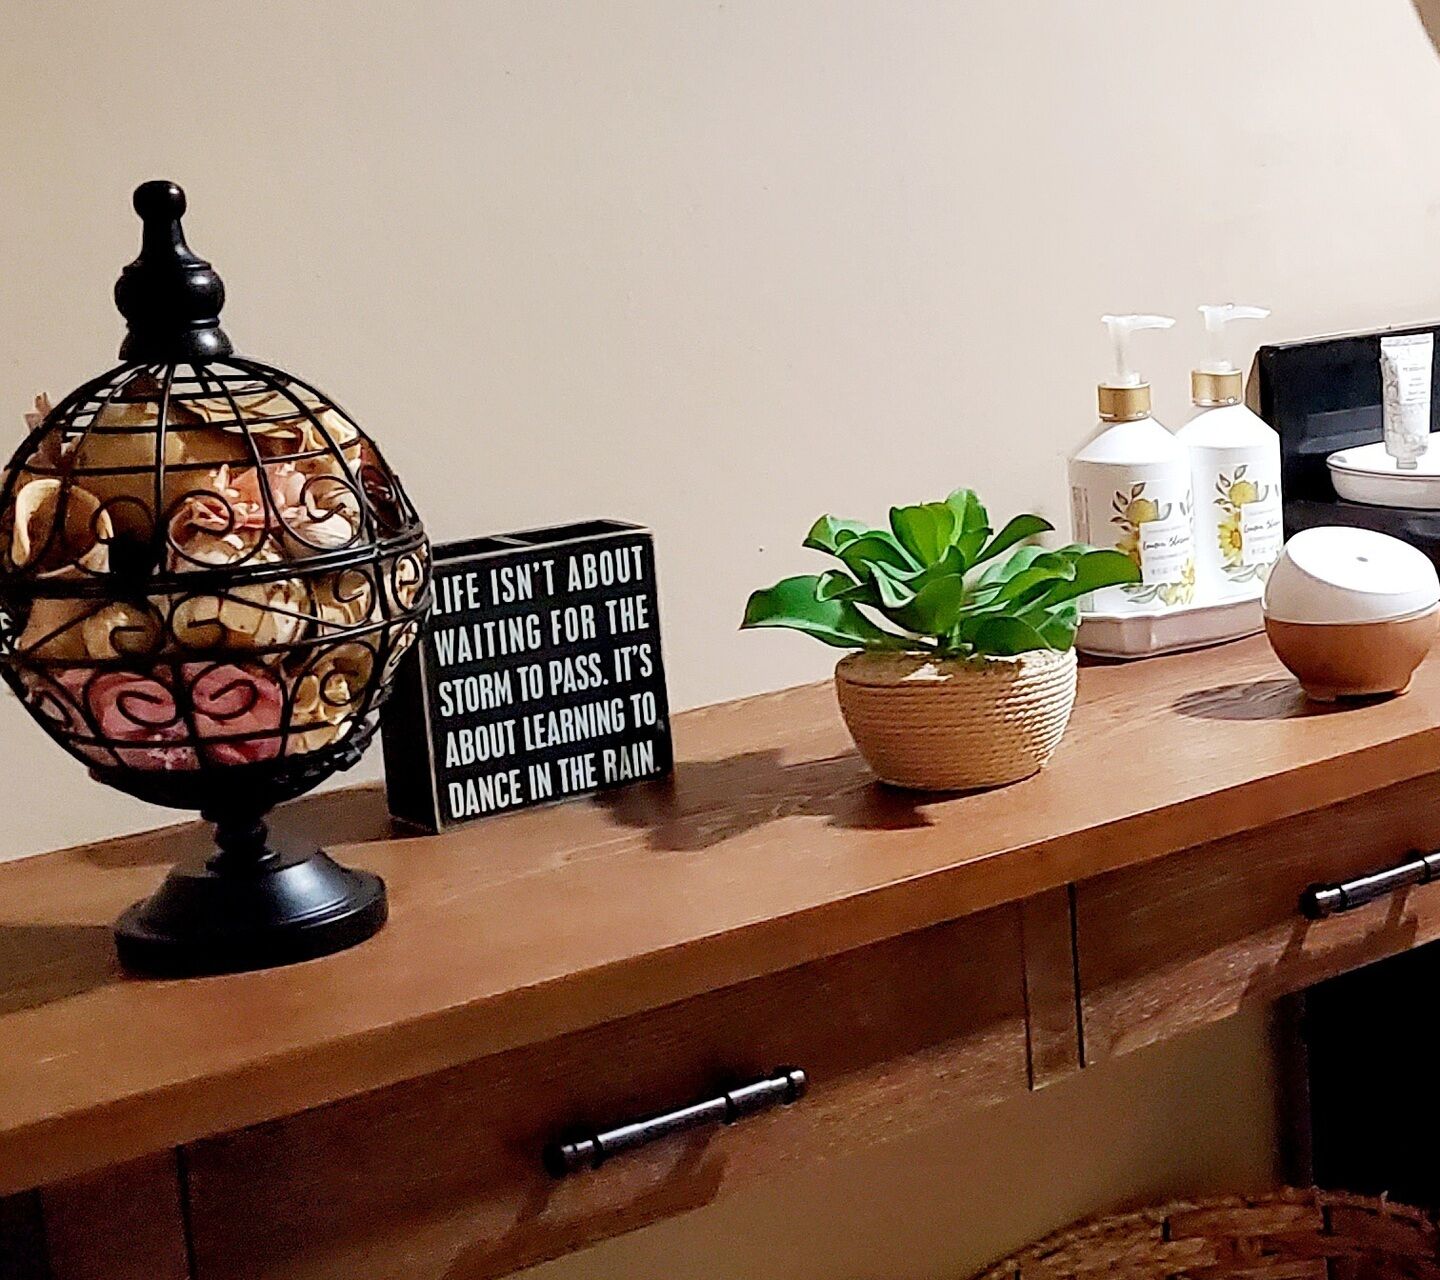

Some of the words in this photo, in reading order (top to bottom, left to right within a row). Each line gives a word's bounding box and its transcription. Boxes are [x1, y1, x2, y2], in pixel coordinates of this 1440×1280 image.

[431, 572, 481, 616] LIFE
[490, 559, 555, 606] ISN'T
[567, 545, 644, 593] ABOUT
[433, 613, 542, 667] WAITING
[550, 604, 597, 646] FOR
[605, 594, 650, 635] THE
[438, 669, 513, 717] STORM
[517, 664, 544, 702] TO
[549, 652, 609, 696] PASS.
[612, 643, 652, 683] IT'S
[445, 719, 517, 769] ABOUT
[522, 697, 626, 751] LEARNING
[629, 691, 657, 729] TO
[447, 769, 523, 819] DANCE
[528, 762, 552, 801] IN
[557, 753, 598, 793] THE
[602, 739, 661, 784] RAIN.
